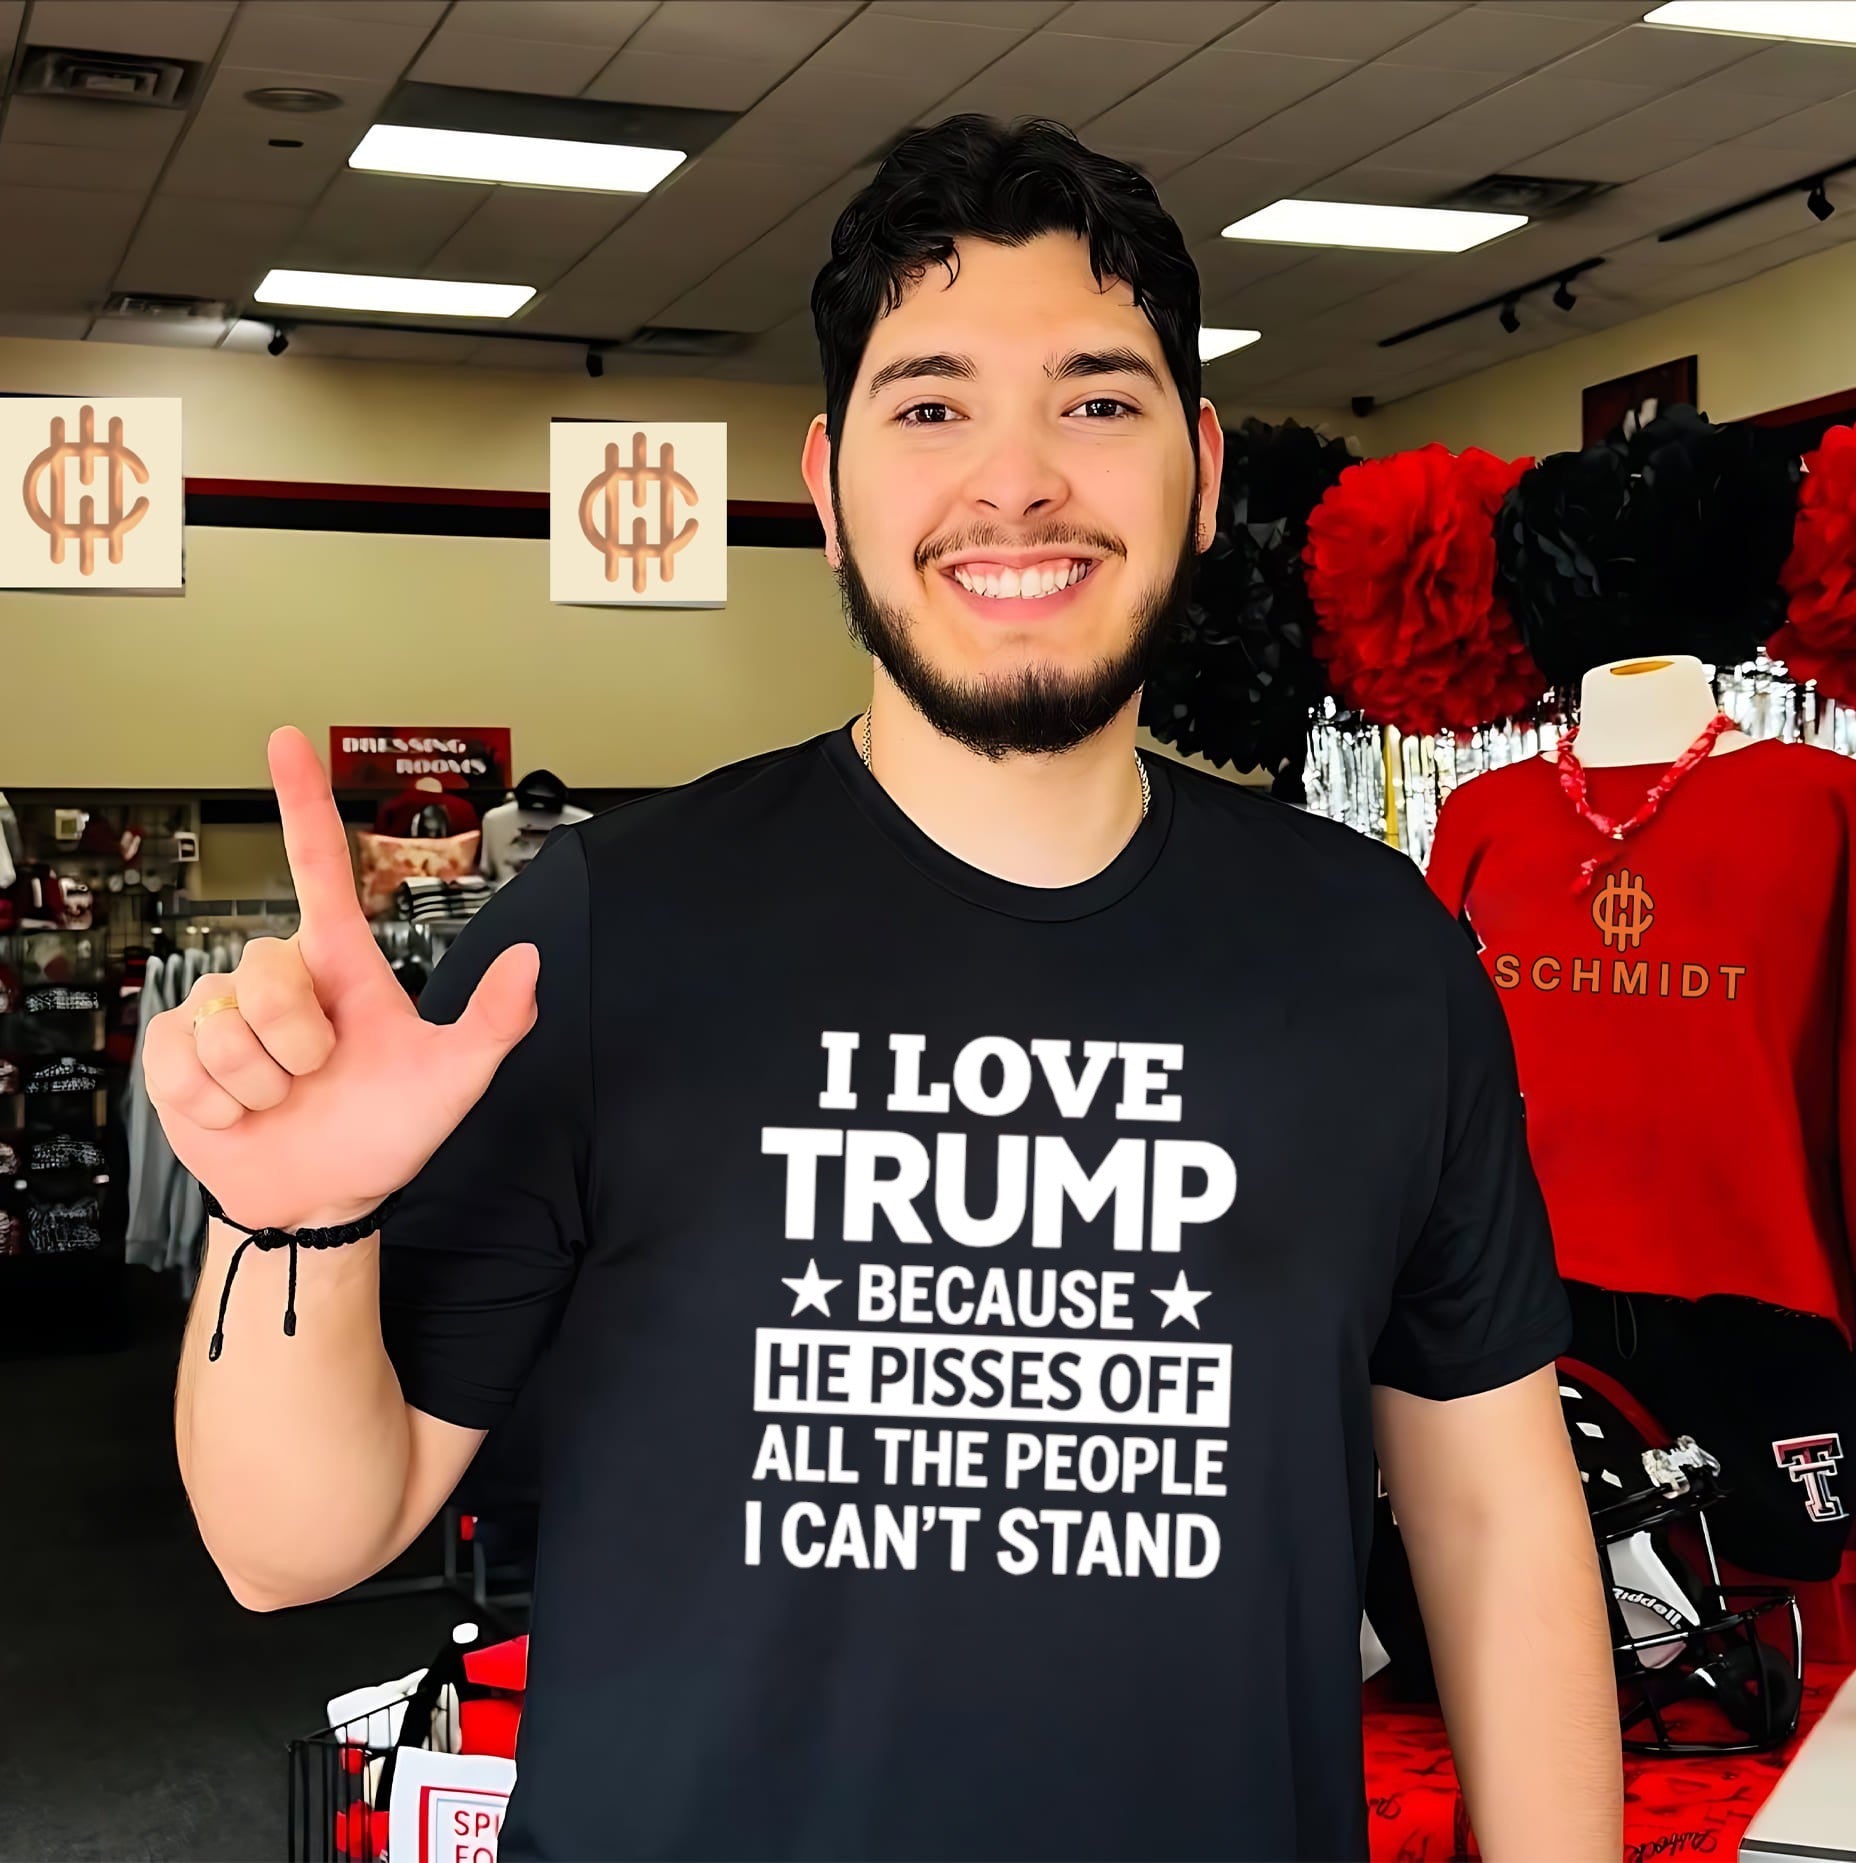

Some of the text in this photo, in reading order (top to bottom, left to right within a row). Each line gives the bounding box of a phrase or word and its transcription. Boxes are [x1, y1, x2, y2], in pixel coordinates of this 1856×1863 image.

[1494, 954, 1747, 1000] SCHMIDT
[819, 1031, 1183, 1122] I LOVE
[761, 1127, 1237, 1252] TRUMP
[858, 1264, 1134, 1330] BECAUSE
[768, 1342, 1220, 1415] HE PISSES OFF
[752, 1424, 1227, 1496] ALL THE PEOPLE
[745, 1501, 1220, 1578] I CAN’T STAND
